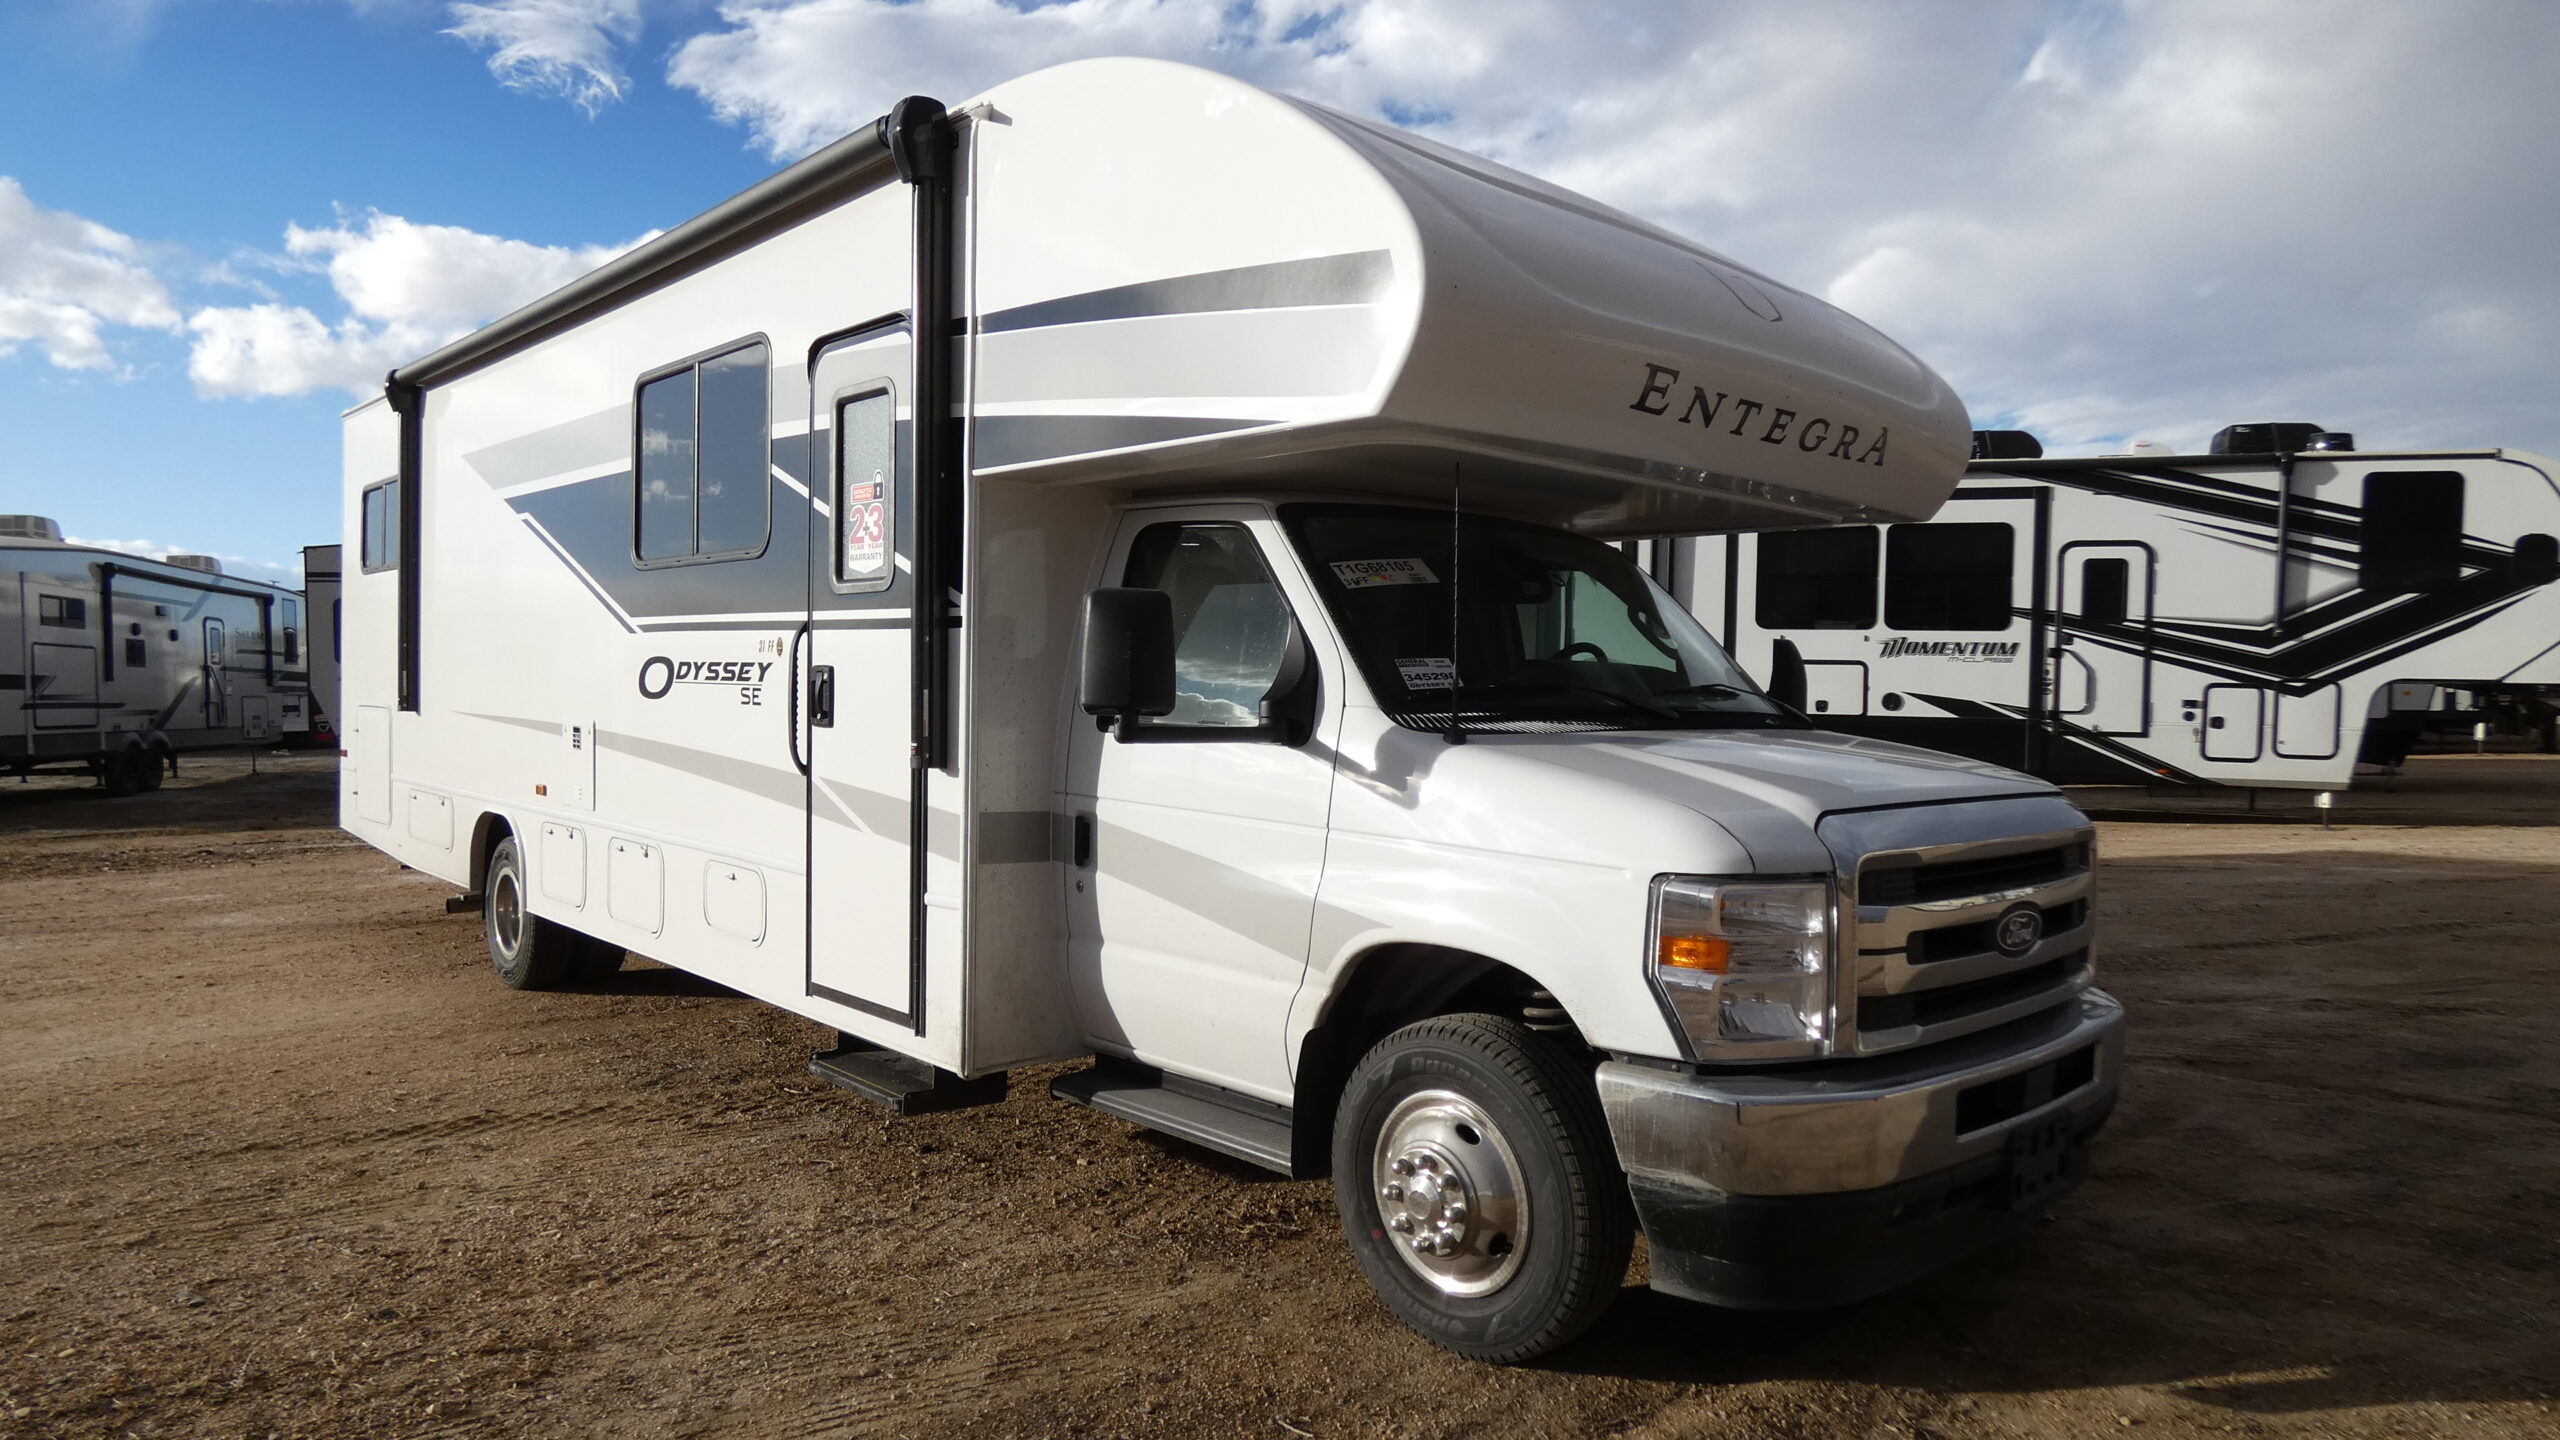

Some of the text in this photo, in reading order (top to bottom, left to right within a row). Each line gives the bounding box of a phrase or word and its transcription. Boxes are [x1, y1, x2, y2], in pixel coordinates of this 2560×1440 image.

[1629, 362, 1889, 467] ENTEGRA
[850, 552, 882, 561] WARRANTY
[1333, 561, 1414, 576] T1G68105
[768, 640, 774, 652] FF
[1878, 637, 2020, 658] MOMENTUM
[639, 656, 773, 699] ODYSSEY
[741, 687, 761, 705] SE
